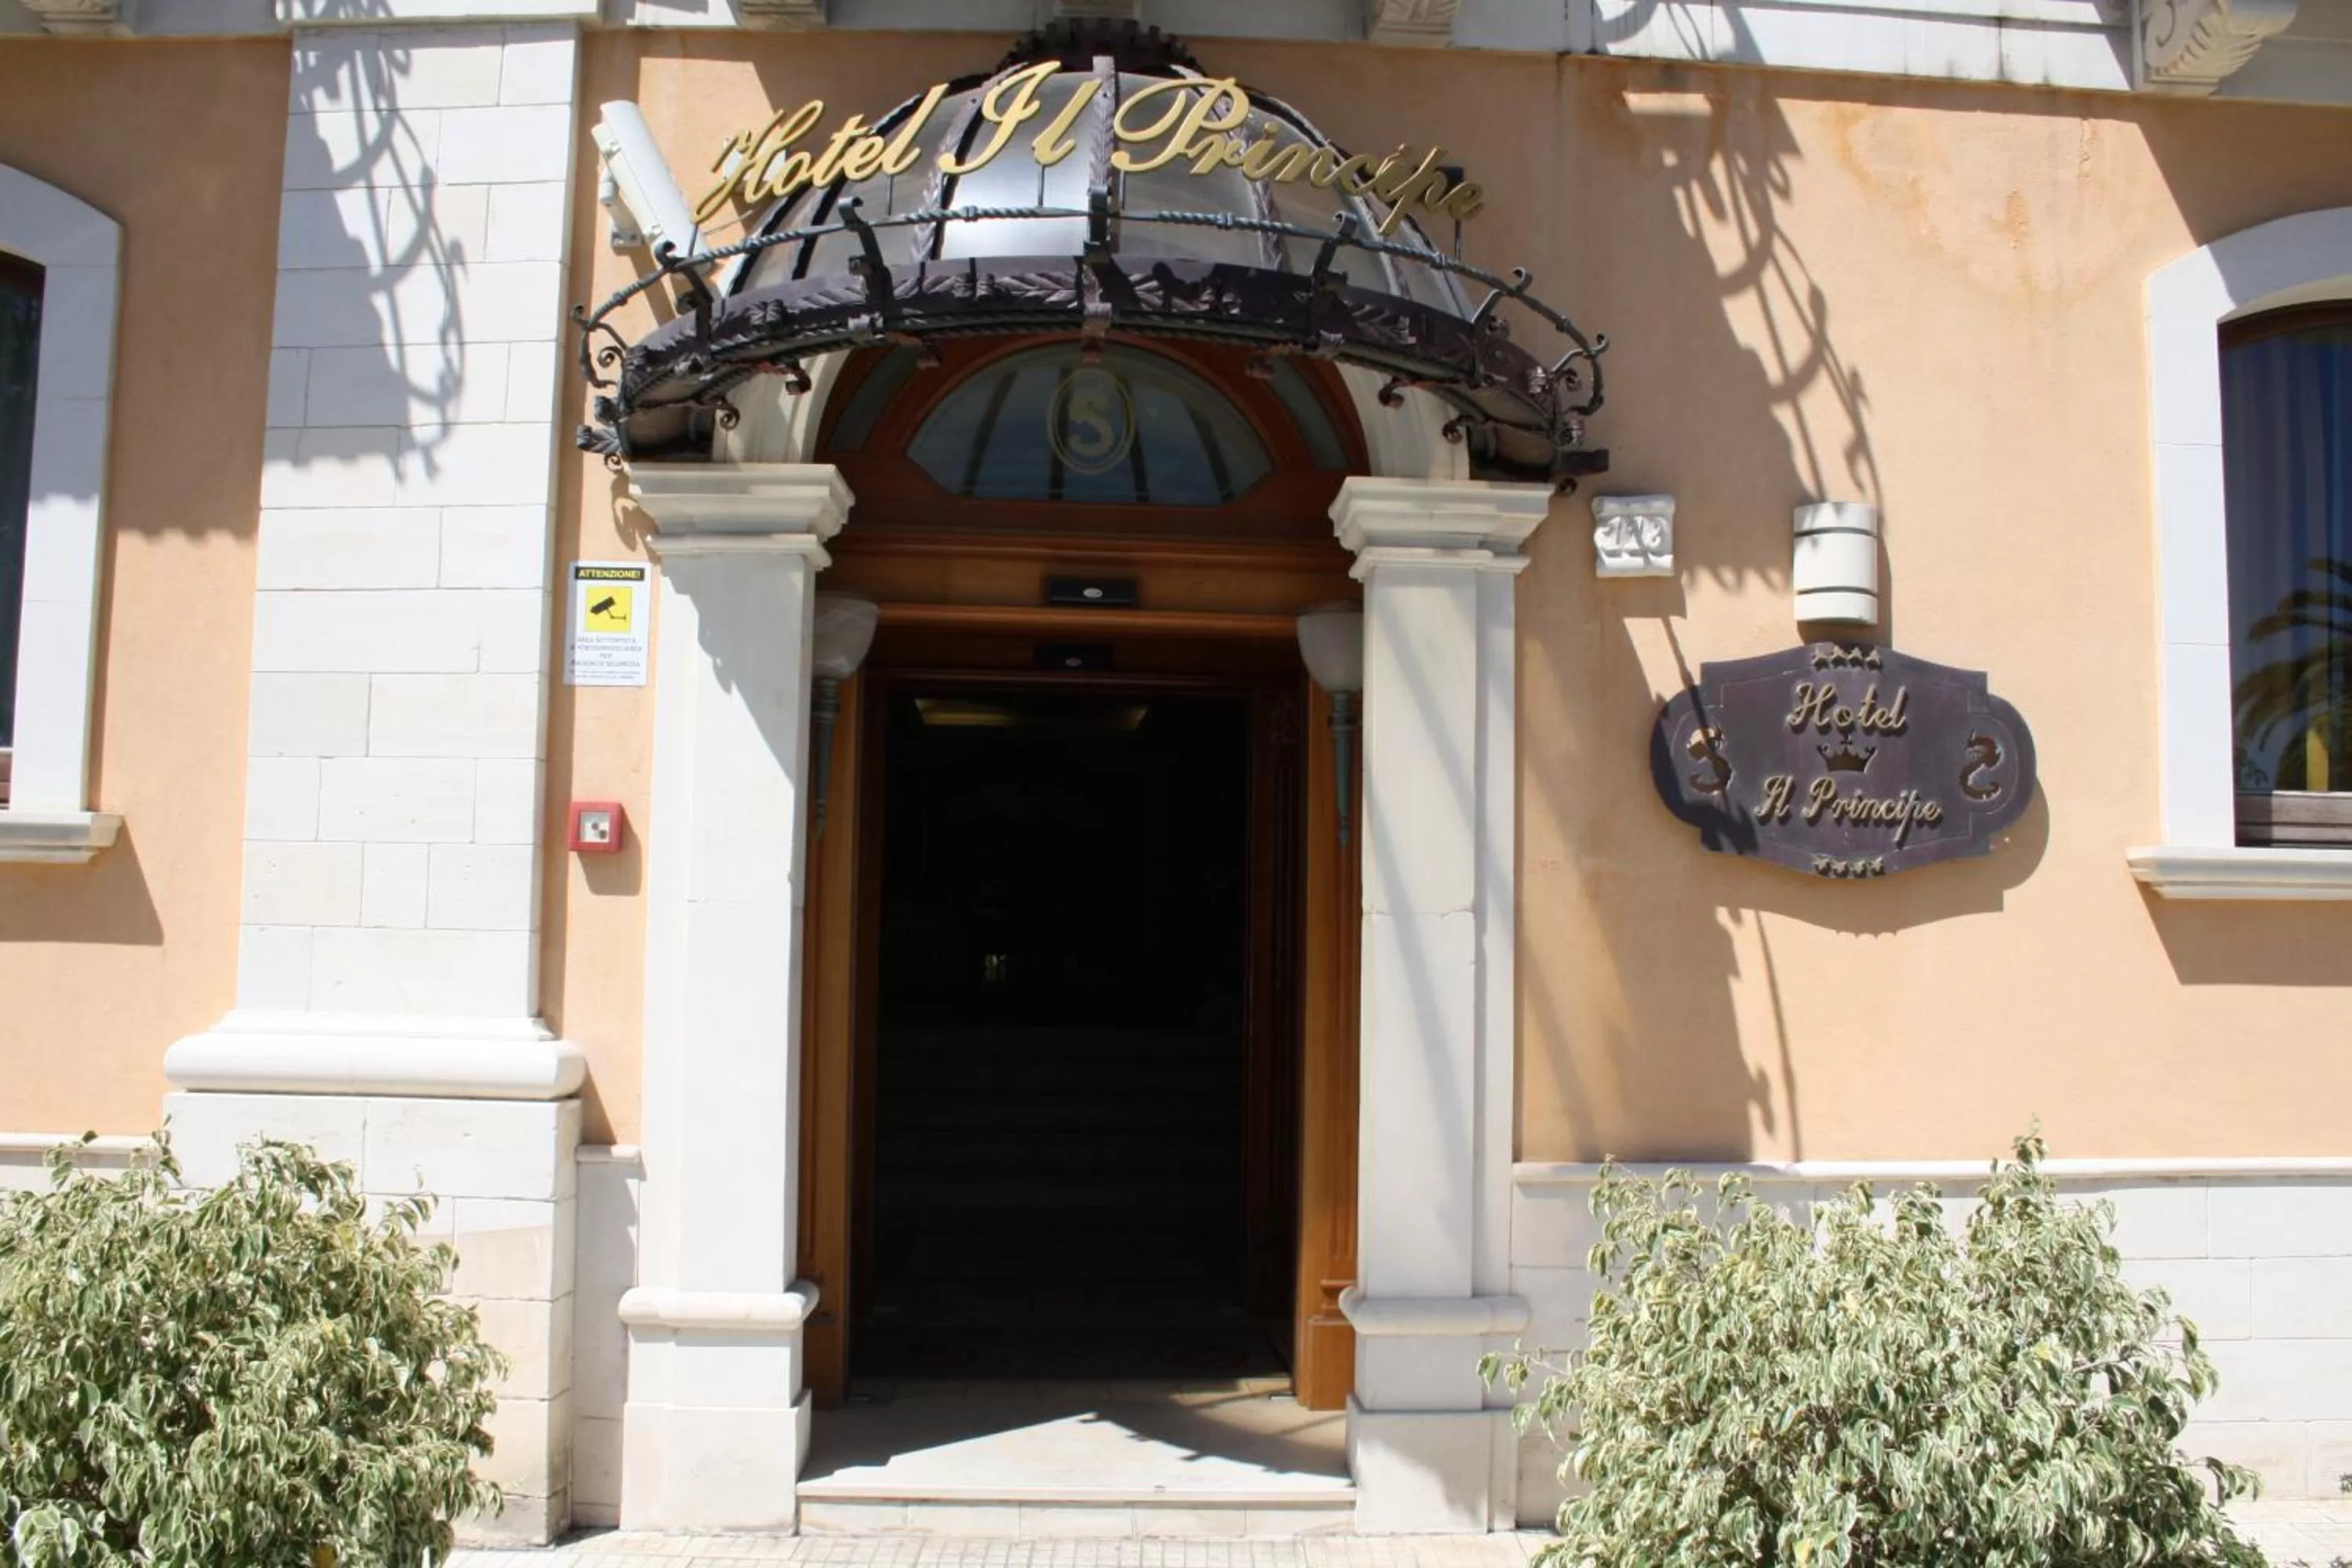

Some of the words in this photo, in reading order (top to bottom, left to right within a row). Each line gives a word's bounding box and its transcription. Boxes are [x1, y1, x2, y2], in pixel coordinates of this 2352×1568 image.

[695, 82, 950, 223] Hotel
[938, 60, 1102, 176] Il
[1111, 75, 1486, 235] Principe
[1786, 682, 1907, 731] Hotel
[1755, 775, 1793, 819] Il
[1801, 775, 1943, 842] Principe
